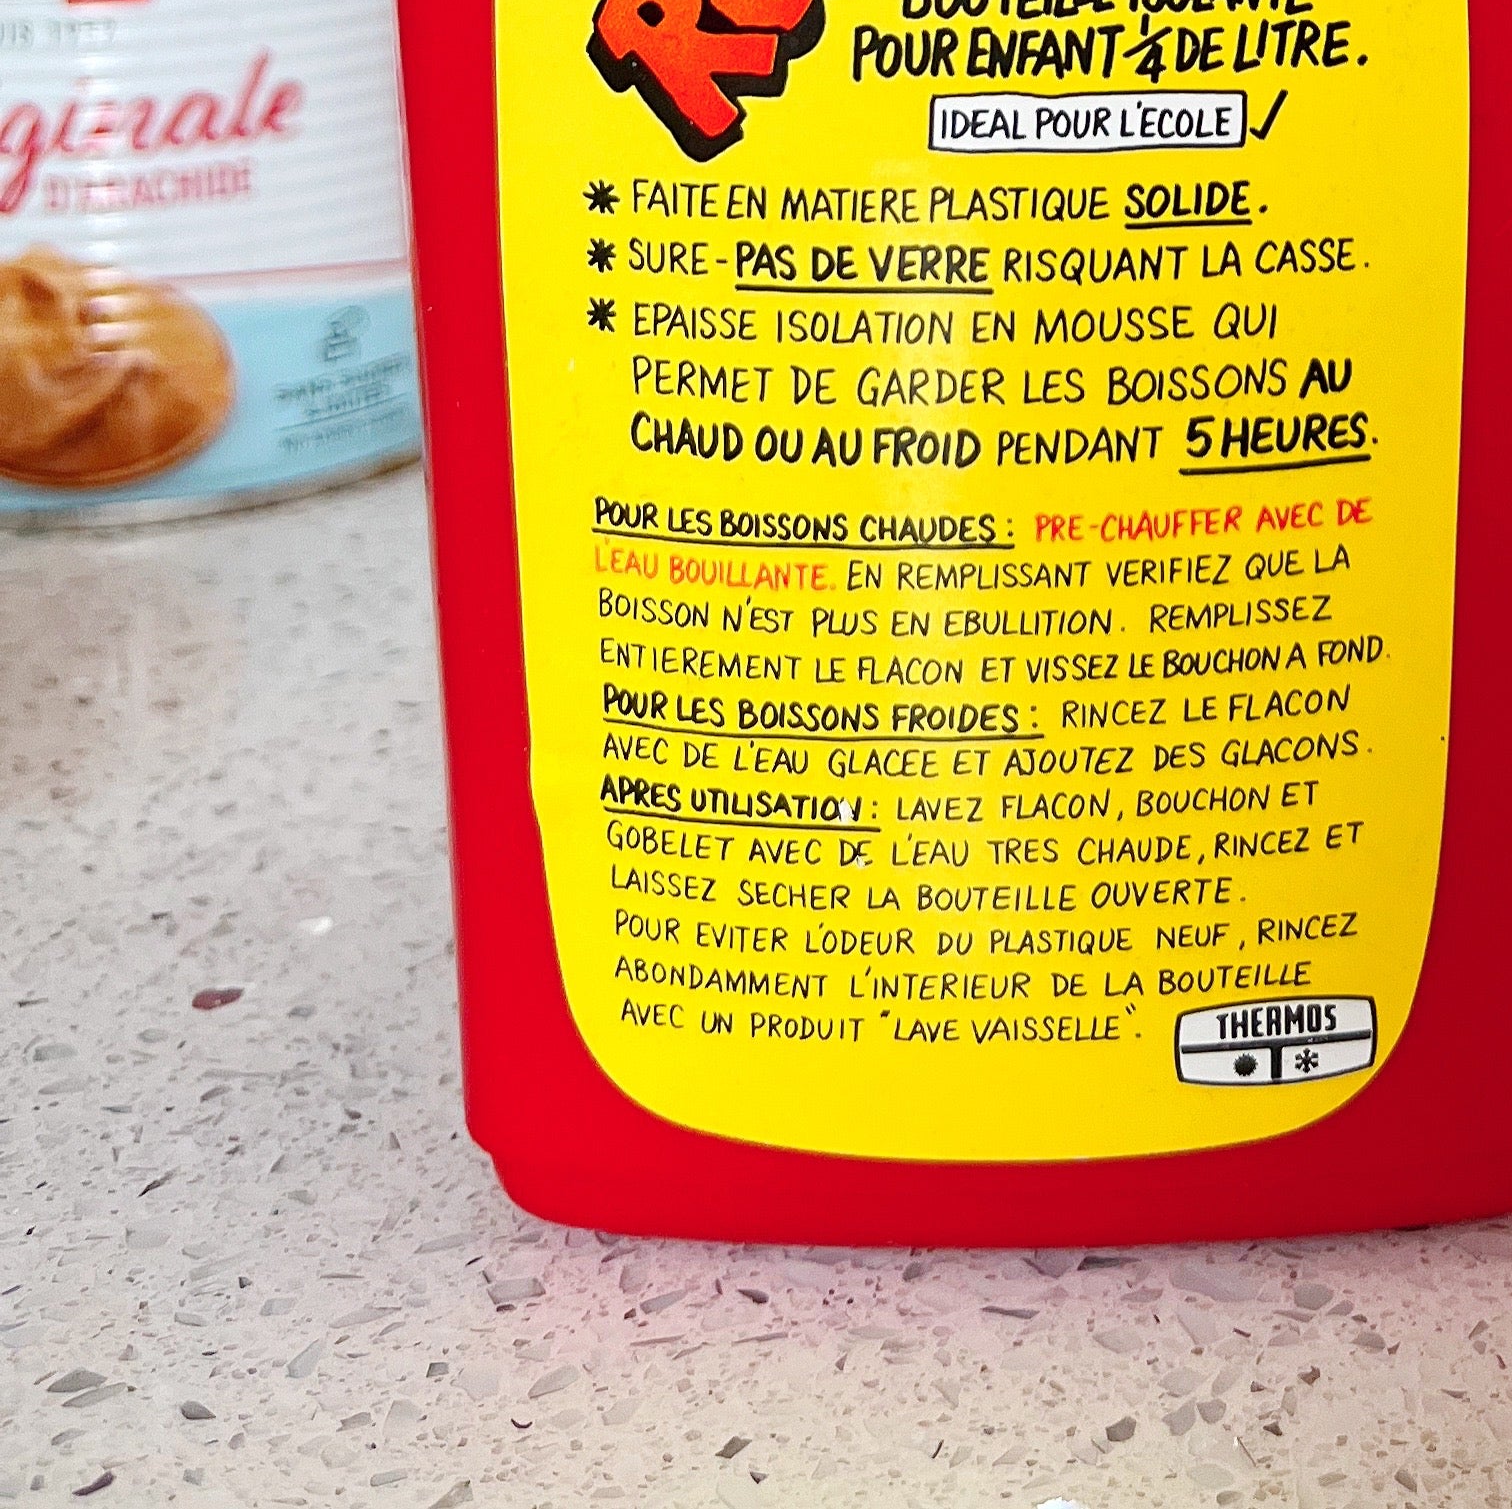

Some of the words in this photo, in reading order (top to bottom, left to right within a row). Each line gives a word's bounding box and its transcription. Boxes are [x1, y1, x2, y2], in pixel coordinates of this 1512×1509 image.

[853, 26, 955, 81] POUR
[967, 24, 1126, 79] ENFANT
[1176, 27, 1224, 72] DE
[1233, 19, 1368, 73] LITRE.
[942, 109, 1026, 140] IDEAL
[1036, 108, 1111, 139] POUR
[1120, 101, 1232, 138] L'ECOLE
[633, 179, 719, 217] FAITE
[727, 185, 766, 219] EN
[781, 188, 919, 223] MATIERE
[930, 187, 1110, 223] PLASTIQUE
[1125, 180, 1268, 220] SOLIDE.
[812, 246, 858, 282] DE
[869, 245, 990, 284] VERRE
[1004, 246, 1188, 286] RISQUANT
[1202, 241, 1242, 278] LA
[1255, 237, 1369, 274] CASSE.
[635, 302, 756, 340] EPAISSE
[777, 310, 953, 344] ISOLATION
[973, 311, 1014, 343] EN
[1035, 306, 1194, 345] MOUSSE
[1214, 302, 1276, 340] QUI
[633, 355, 772, 402] PERMET
[791, 365, 836, 404] DE
[858, 367, 1005, 407] GARDER
[1024, 368, 1084, 404] LES
[1108, 358, 1287, 405] BOISSONS
[1299, 358, 1352, 399] AU
[631, 411, 743, 461] CHAUD
[755, 426, 803, 463] OU
[812, 427, 862, 467] AU
[874, 427, 981, 468] FROID
[997, 426, 1163, 466] PENDANT
[594, 496, 658, 531] POUR
[667, 508, 712, 538] LES
[720, 509, 848, 544] BOISSONS
[1036, 506, 1242, 542] PRE-CHAUFFER
[1256, 501, 1323, 532] AVEC
[1336, 498, 1372, 526] DE
[597, 538, 660, 578] L'EAU
[669, 553, 837, 592] BOUILLANTE.
[847, 560, 881, 591] EN
[898, 561, 1091, 590] REMPLISSANT
[1106, 554, 1232, 587] VERIFIEZ
[1245, 550, 1304, 580] QUE
[1315, 543, 1350, 574] LA
[600, 588, 708, 627] BOISSON
[723, 596, 793, 633] N'EST
[812, 607, 877, 637] PLUS
[892, 611, 929, 636] EN
[945, 609, 1125, 636] EBULLITION.
[1150, 595, 1332, 633] REMPLISSEZ
[601, 638, 801, 680] ENTIEREMENT
[816, 658, 845, 683] LE
[858, 656, 962, 685] FLACON
[981, 657, 1016, 683] ET
[1026, 654, 1118, 683] VISSEZ
[1129, 653, 1155, 678] LE
[1163, 646, 1280, 679] BOUCHON
[1285, 642, 1306, 670] A
[1318, 635, 1390, 667] FOND.
[603, 683, 668, 721] POUR
[677, 697, 724, 727] LES
[738, 699, 879, 732] BOISSONS
[1063, 699, 1166, 728] RINCEZ
[1184, 696, 1217, 722] LE
[1229, 684, 1350, 722] FLACON
[603, 733, 668, 764] AVEC
[684, 742, 718, 768] DE
[734, 739, 810, 774] L'EAU
[828, 749, 938, 778] GLACEE
[953, 750, 990, 775] ET
[1004, 747, 1133, 777] AJOUTEZ
[1154, 742, 1205, 772] DES
[1221, 730, 1372, 768] GLACONS.
[600, 774, 681, 813] APRES
[897, 798, 982, 822] LAVEZ
[1002, 788, 1123, 821] FLACON,
[1137, 784, 1270, 817] BOUCHON
[1281, 780, 1319, 807] ET
[607, 819, 735, 860] GOBELET
[749, 838, 821, 864] AVEC
[840, 840, 872, 866] DE
[892, 834, 968, 867] L'EAU
[987, 838, 1058, 864] TRES
[1078, 835, 1204, 865] CHAUDE,
[1214, 827, 1309, 858] RINCEZ
[1326, 821, 1364, 849] ET
[612, 865, 715, 901] LAISSEZ
[738, 879, 850, 910] SECHER
[868, 888, 900, 910] LA
[918, 885, 1076, 911] BOUTEILLE
[1091, 877, 1245, 908] OUVERTE.
[616, 909, 680, 944] POUR
[697, 923, 788, 952] EVITER
[806, 923, 914, 955] L'ODEUR
[937, 933, 972, 955] DU
[991, 928, 1132, 955] PLASTIQUE
[1258, 912, 1357, 945] RINCEZ
[615, 956, 827, 999] ABONDAMMENT
[851, 966, 1030, 1000] L'INTERIEUR
[1051, 973, 1087, 997] DE
[1105, 972, 1144, 996] LA
[1159, 961, 1313, 997] BOUTEILLE
[621, 999, 683, 1028] AVEC
[702, 1012, 732, 1034] UN
[751, 1012, 864, 1042] PRODUIT
[1216, 1004, 1337, 1040] THERMOS
